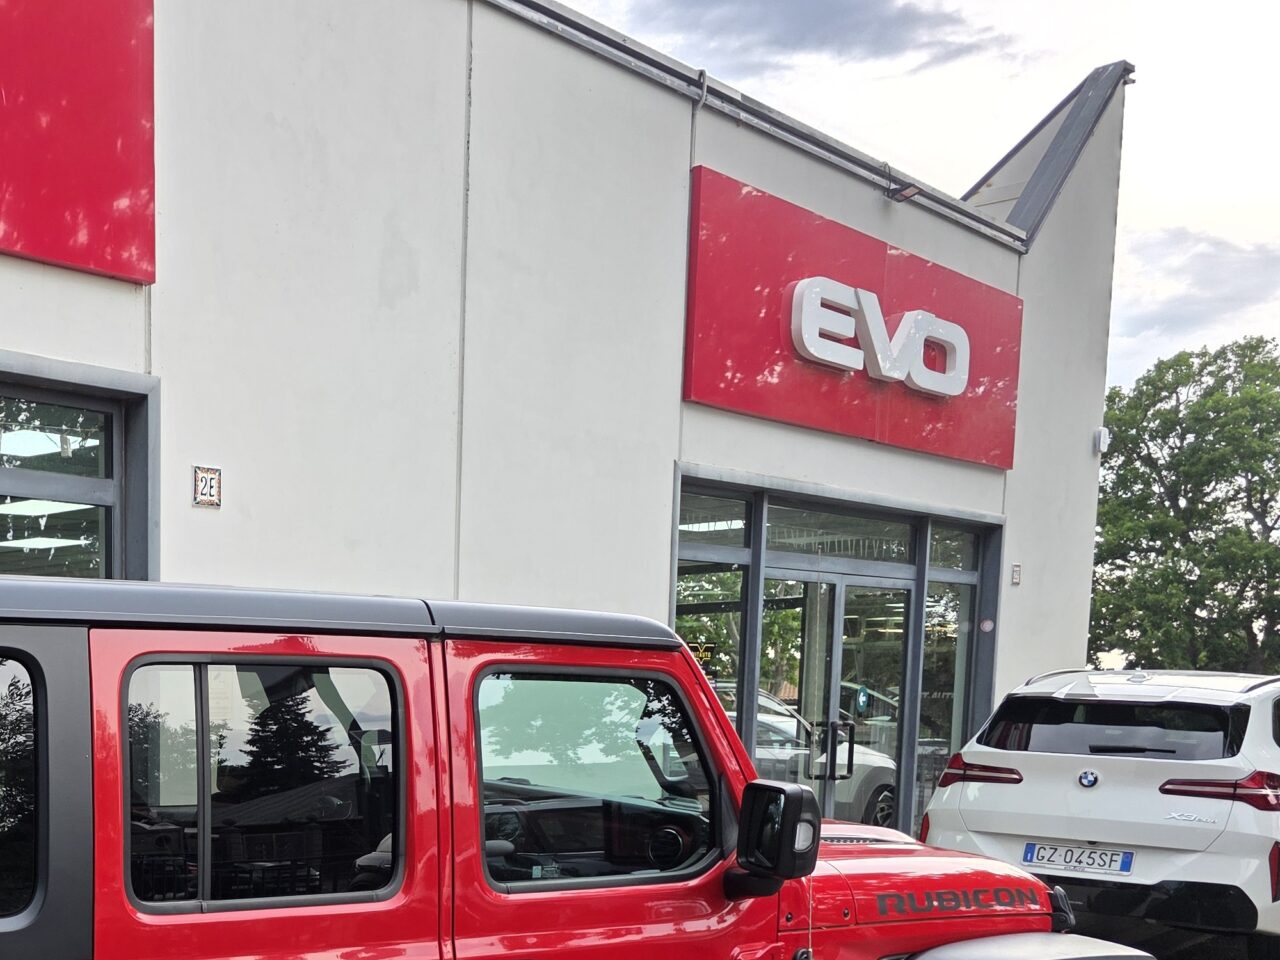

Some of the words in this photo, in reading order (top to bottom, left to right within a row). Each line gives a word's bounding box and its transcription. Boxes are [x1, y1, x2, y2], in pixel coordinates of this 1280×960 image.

[792, 276, 970, 396] EVO
[200, 476, 216, 498] 2E
[1035, 846, 1059, 863] GZ
[1063, 849, 1121, 869] 045SF
[876, 887, 1040, 916] RUBICON
